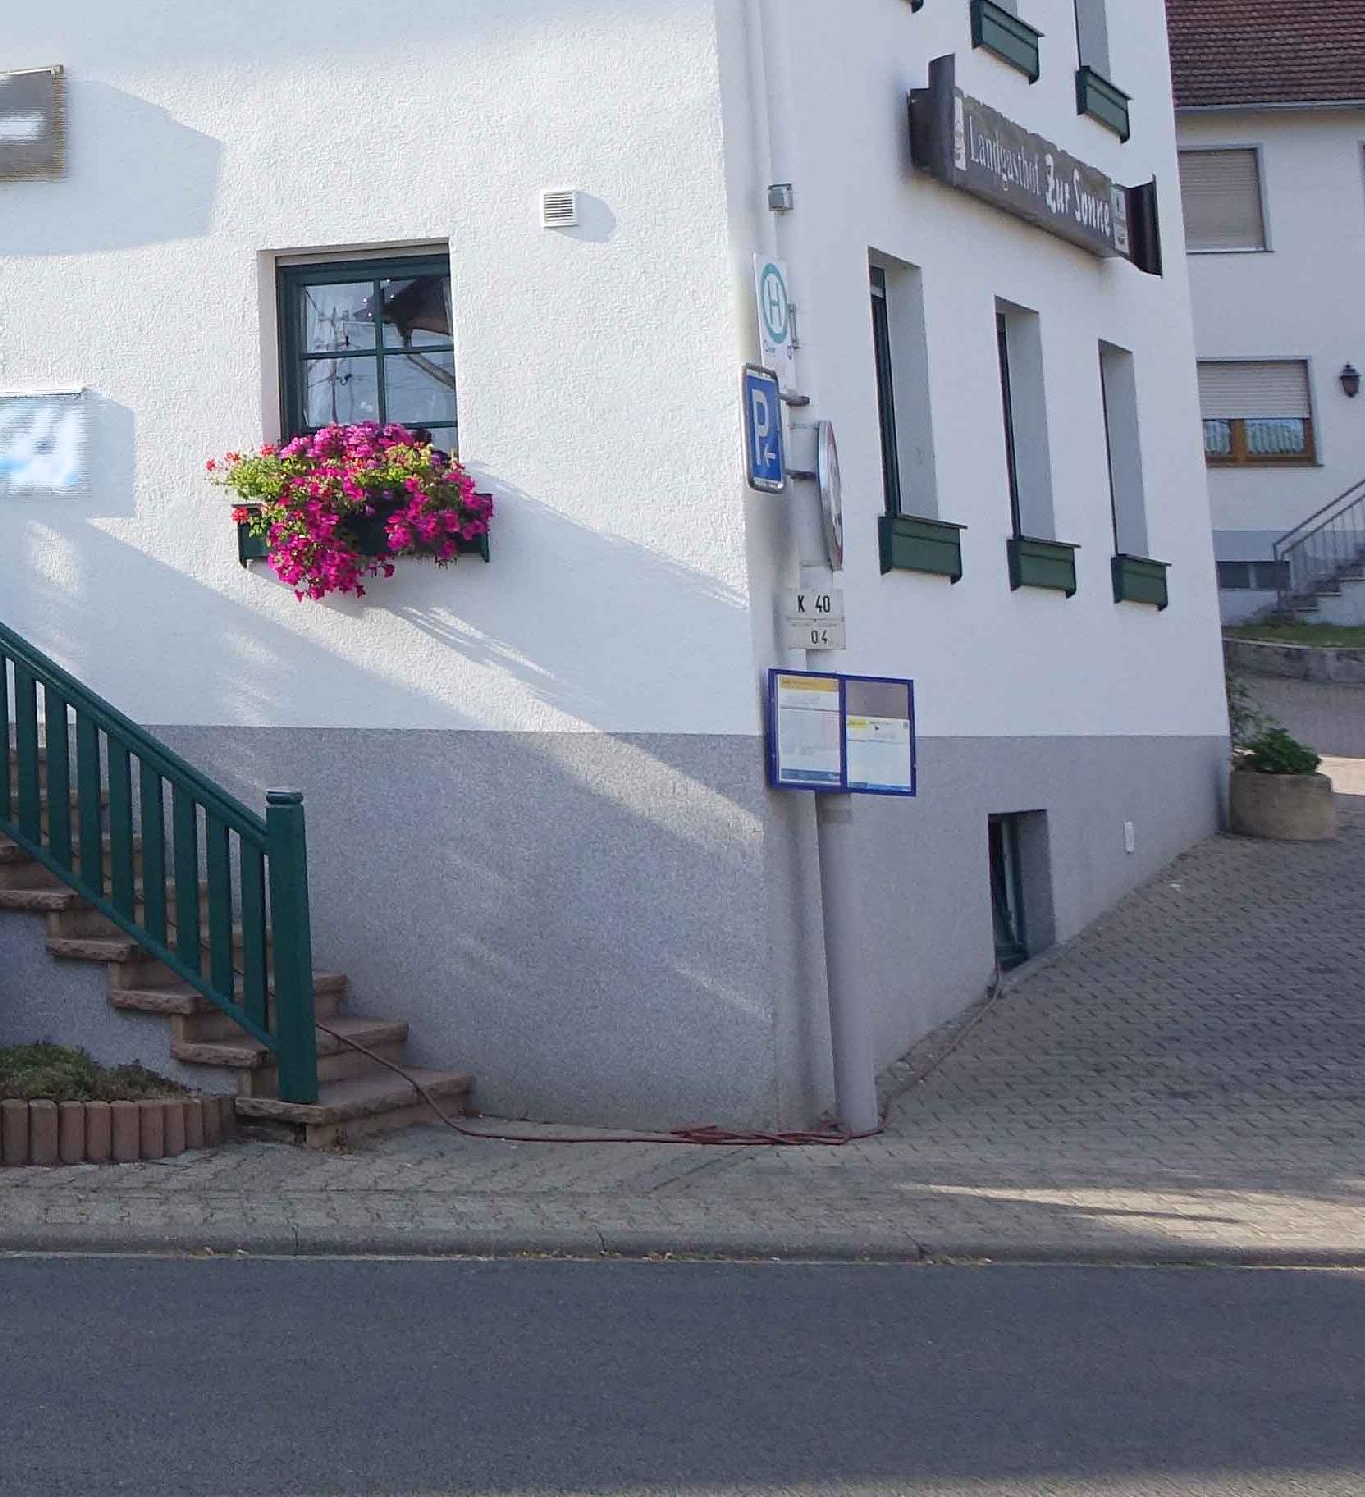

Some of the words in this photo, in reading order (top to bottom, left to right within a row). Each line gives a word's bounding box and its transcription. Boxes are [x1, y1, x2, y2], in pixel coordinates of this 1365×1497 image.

[968, 115, 1040, 196] Landgasthof
[1045, 153, 1070, 214] Zur
[1073, 168, 1111, 237] Sonne
[767, 279, 782, 327] H
[751, 389, 769, 466] P
[797, 594, 806, 613] K
[815, 594, 831, 613] 40
